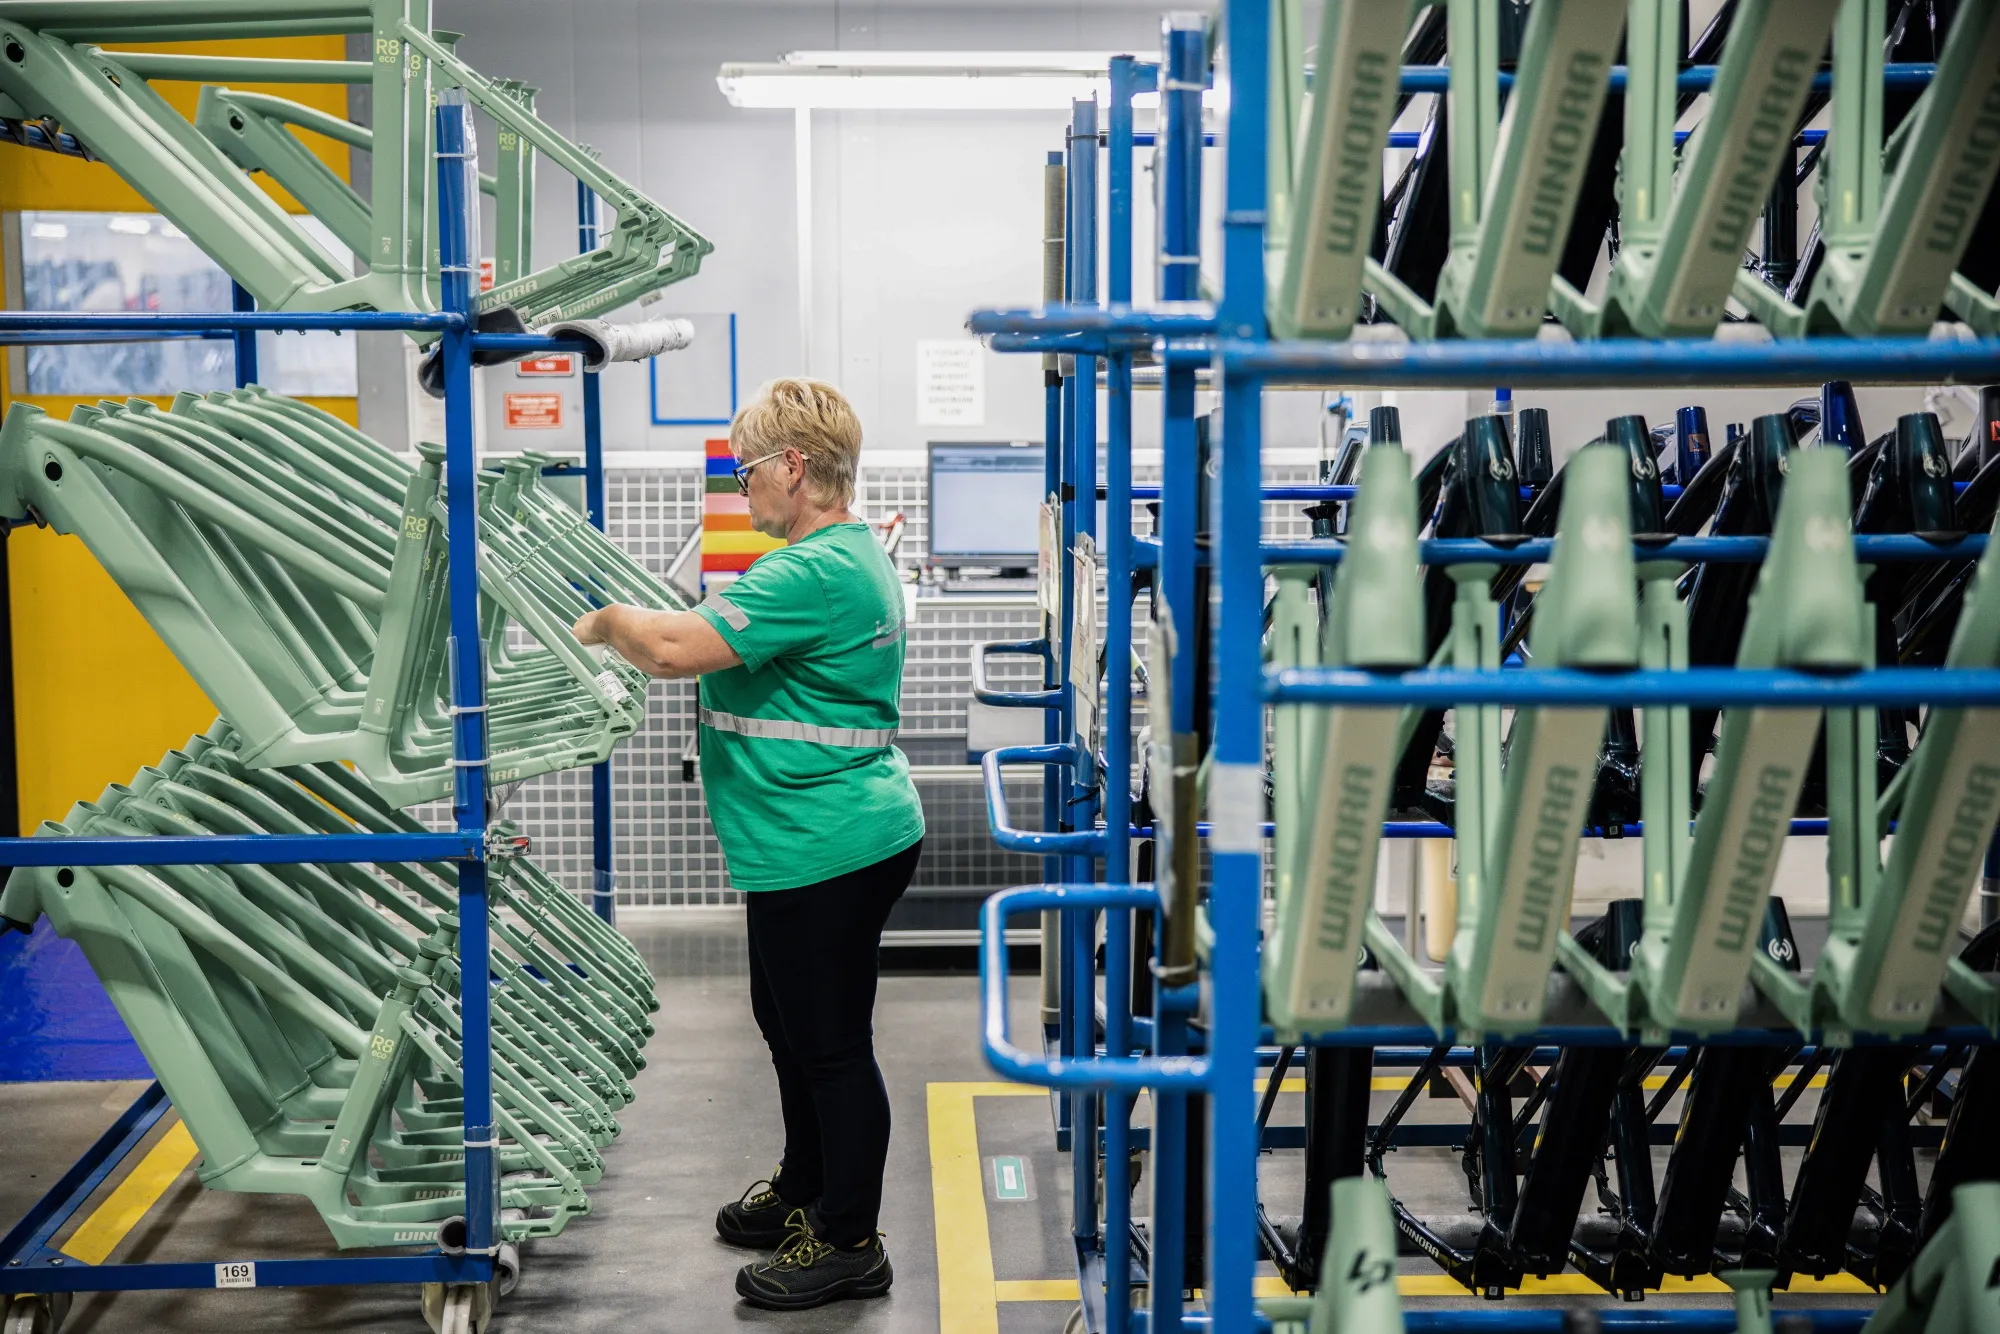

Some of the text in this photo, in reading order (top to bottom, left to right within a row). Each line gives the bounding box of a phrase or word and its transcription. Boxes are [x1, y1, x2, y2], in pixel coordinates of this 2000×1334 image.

[376, 39, 399, 55] R8
[1327, 50, 1389, 255] WINORA
[1523, 50, 1602, 255] WINORA
[1708, 47, 1810, 253] WINORA
[480, 280, 538, 310] INORA
[404, 516, 427, 532] R8
[406, 532, 422, 540] eco
[1318, 762, 1377, 952] WINORA
[1514, 763, 1581, 953] WINORA
[1714, 763, 1793, 954] WINORA
[371, 1034, 394, 1053] R8
[371, 1050, 387, 1059] eco
[1399, 1219, 1440, 1258] WINORA
[222, 1265, 249, 1277] 169
